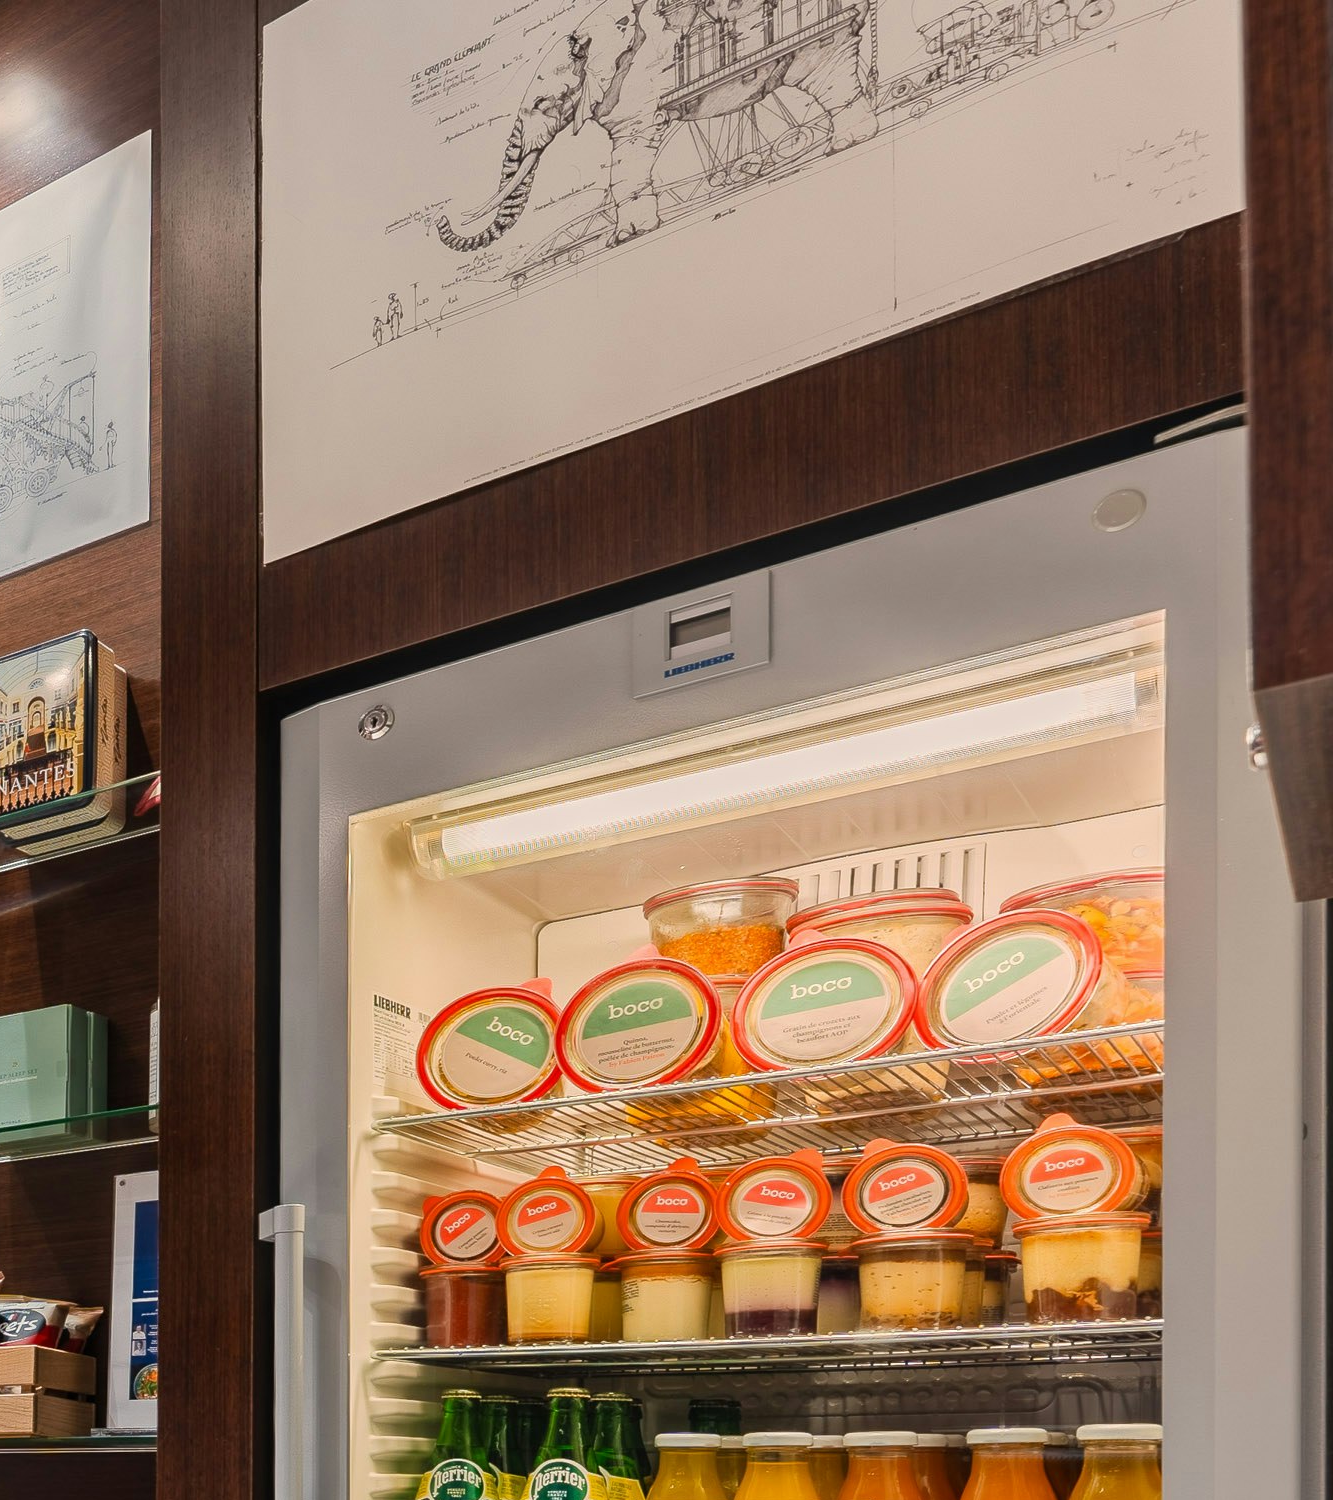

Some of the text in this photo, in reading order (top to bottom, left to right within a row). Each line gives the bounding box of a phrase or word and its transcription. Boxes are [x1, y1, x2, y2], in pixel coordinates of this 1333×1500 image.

[664, 652, 735, 678] LIEBHERR
[963, 951, 1026, 994] boco
[789, 976, 853, 1000] boco
[373, 994, 411, 1020] LIEBHERR
[608, 997, 663, 1020] boco
[486, 1016, 534, 1046] boco
[782, 1024, 807, 1034] Gratin
[1043, 1156, 1086, 1173] boco
[760, 1185, 796, 1200] boco
[879, 1173, 917, 1192] boco
[526, 1201, 558, 1217] boco
[656, 1195, 689, 1206] boco
[444, 1212, 472, 1234] boco
